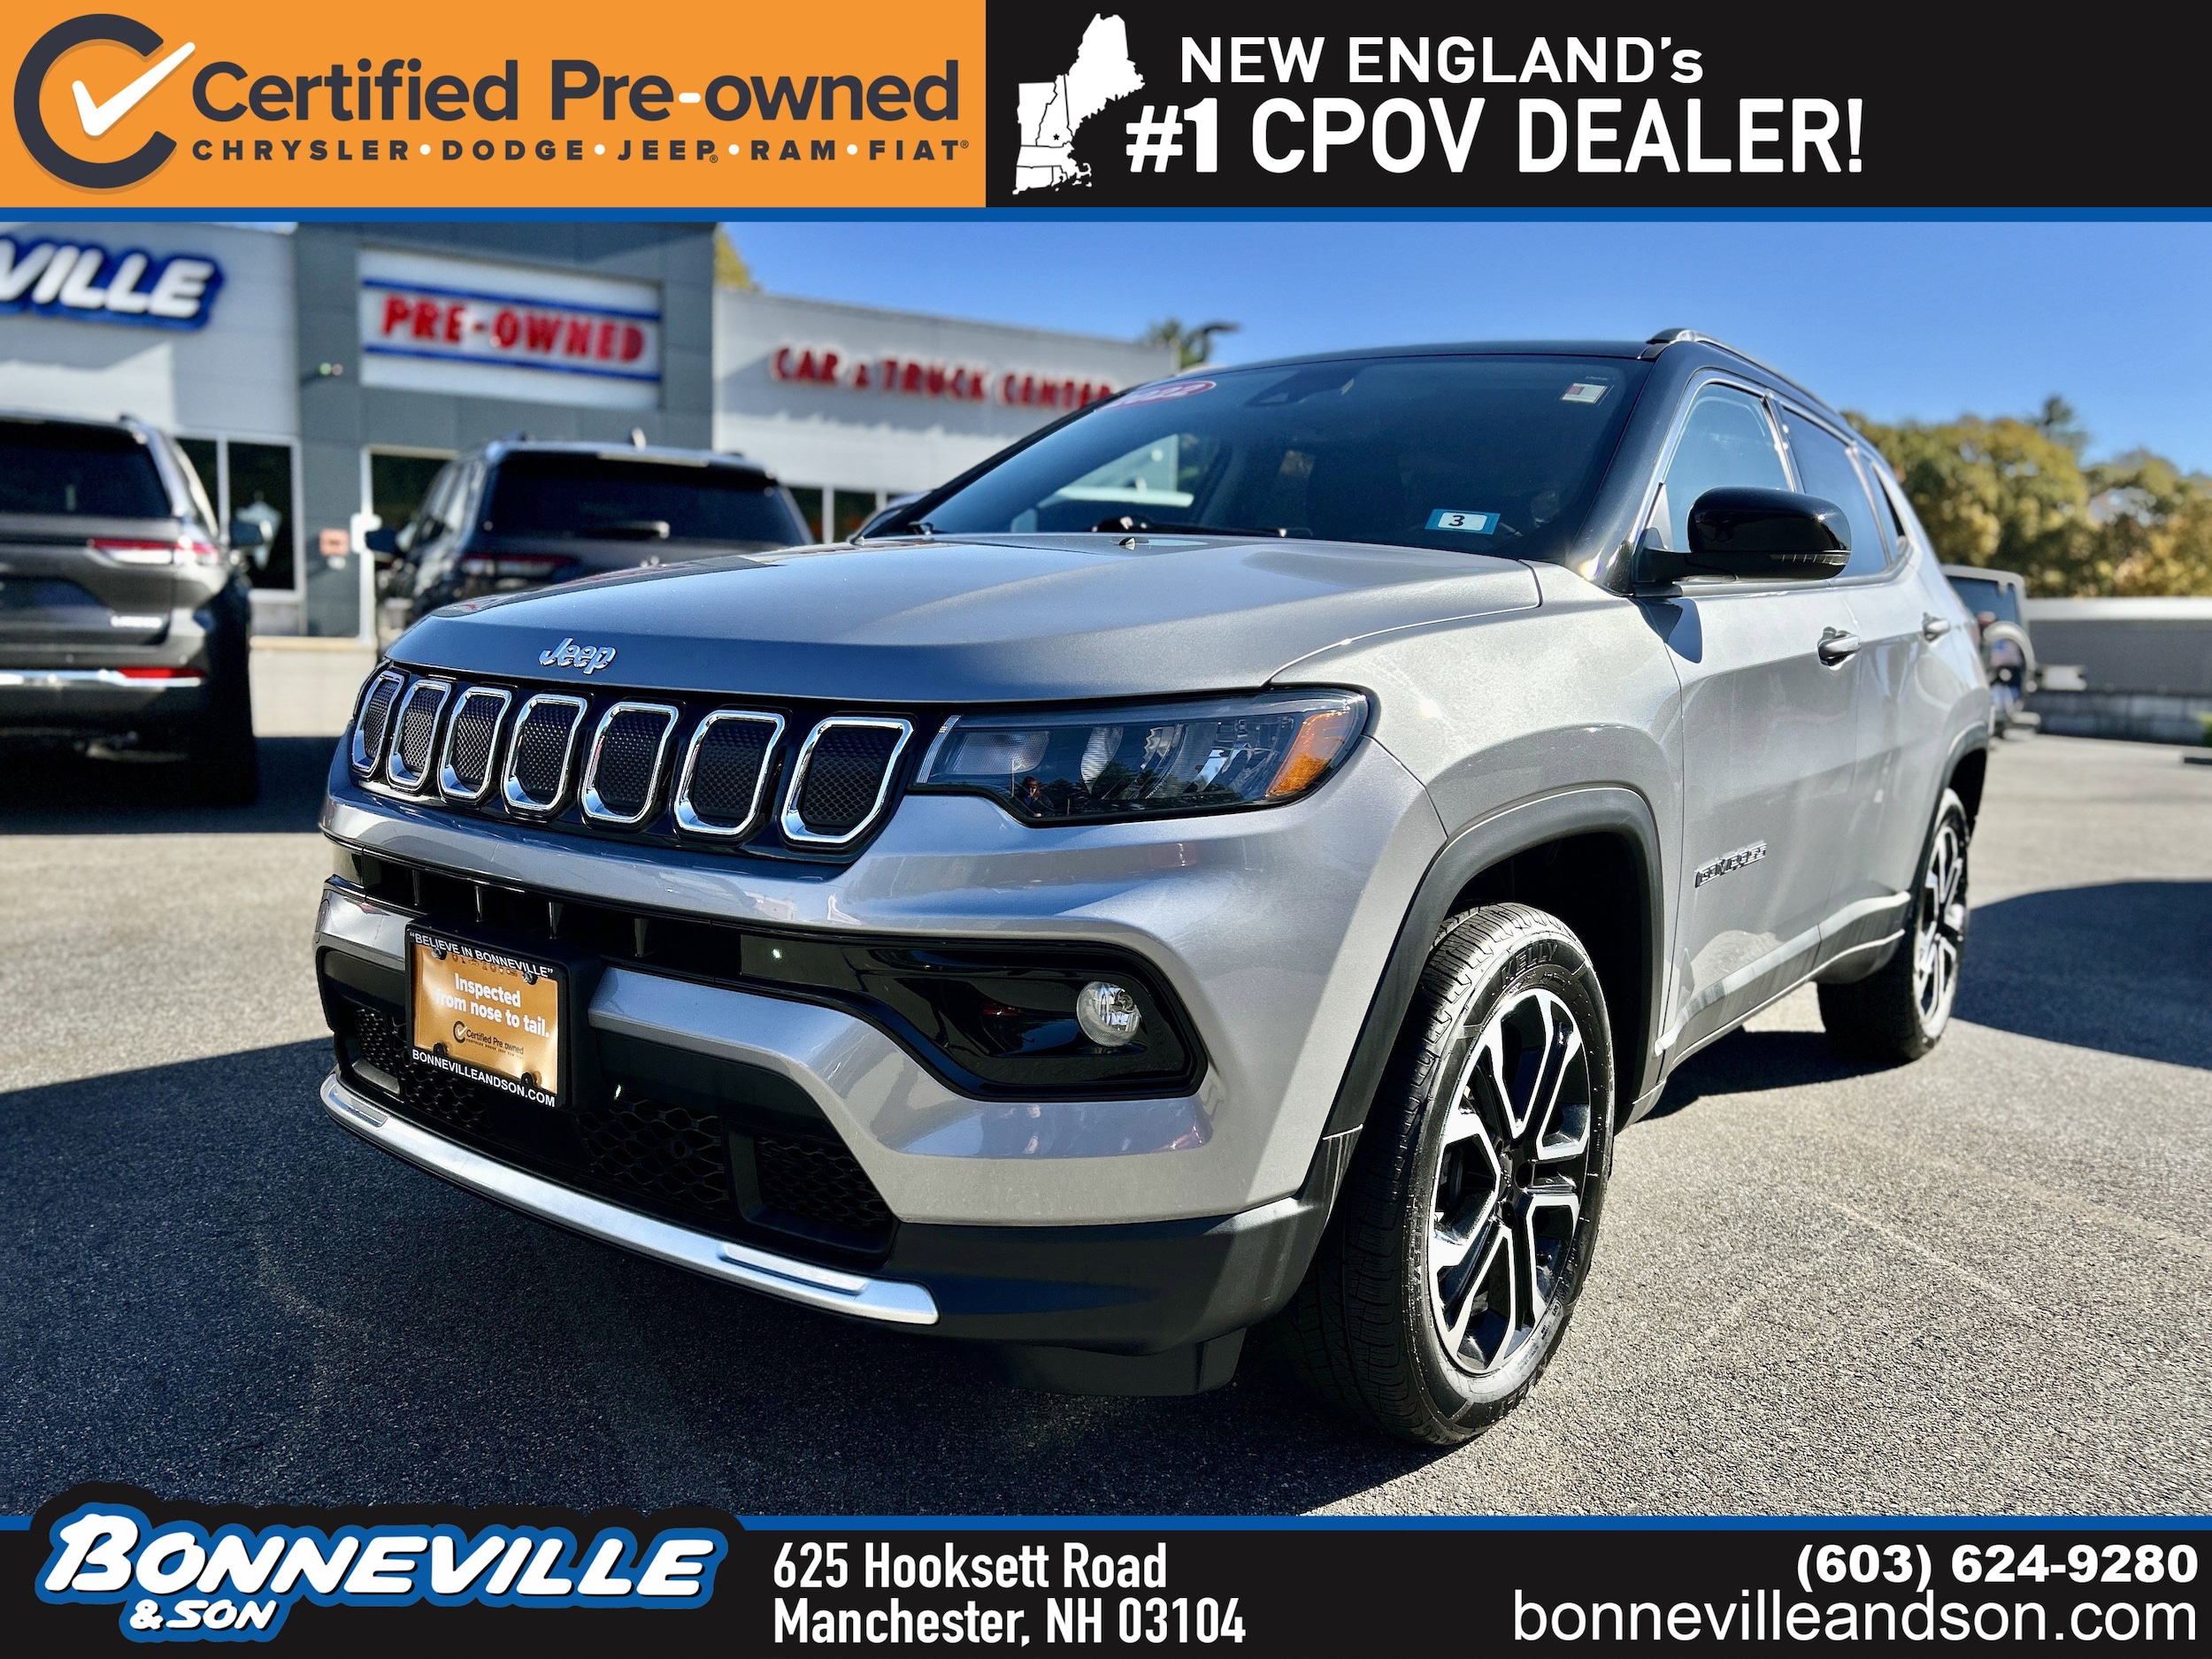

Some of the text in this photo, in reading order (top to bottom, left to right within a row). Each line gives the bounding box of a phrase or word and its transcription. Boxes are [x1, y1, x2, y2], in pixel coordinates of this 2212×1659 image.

[380, 293, 646, 364] PRE-OWNED
[774, 347, 841, 382] CAR
[879, 358, 985, 401] TRUCK
[1448, 515, 1465, 526] 3
[539, 637, 618, 675] Jeep
[461, 946, 472, 956] IN
[1502, 941, 1558, 990] KELLY
[454, 972, 521, 1008] Inspected
[434, 987, 549, 1039] from nose to tail.
[466, 1029, 492, 1044] Certified
[412, 1048, 556, 1108] BONNEVILLEANDSON.COM
